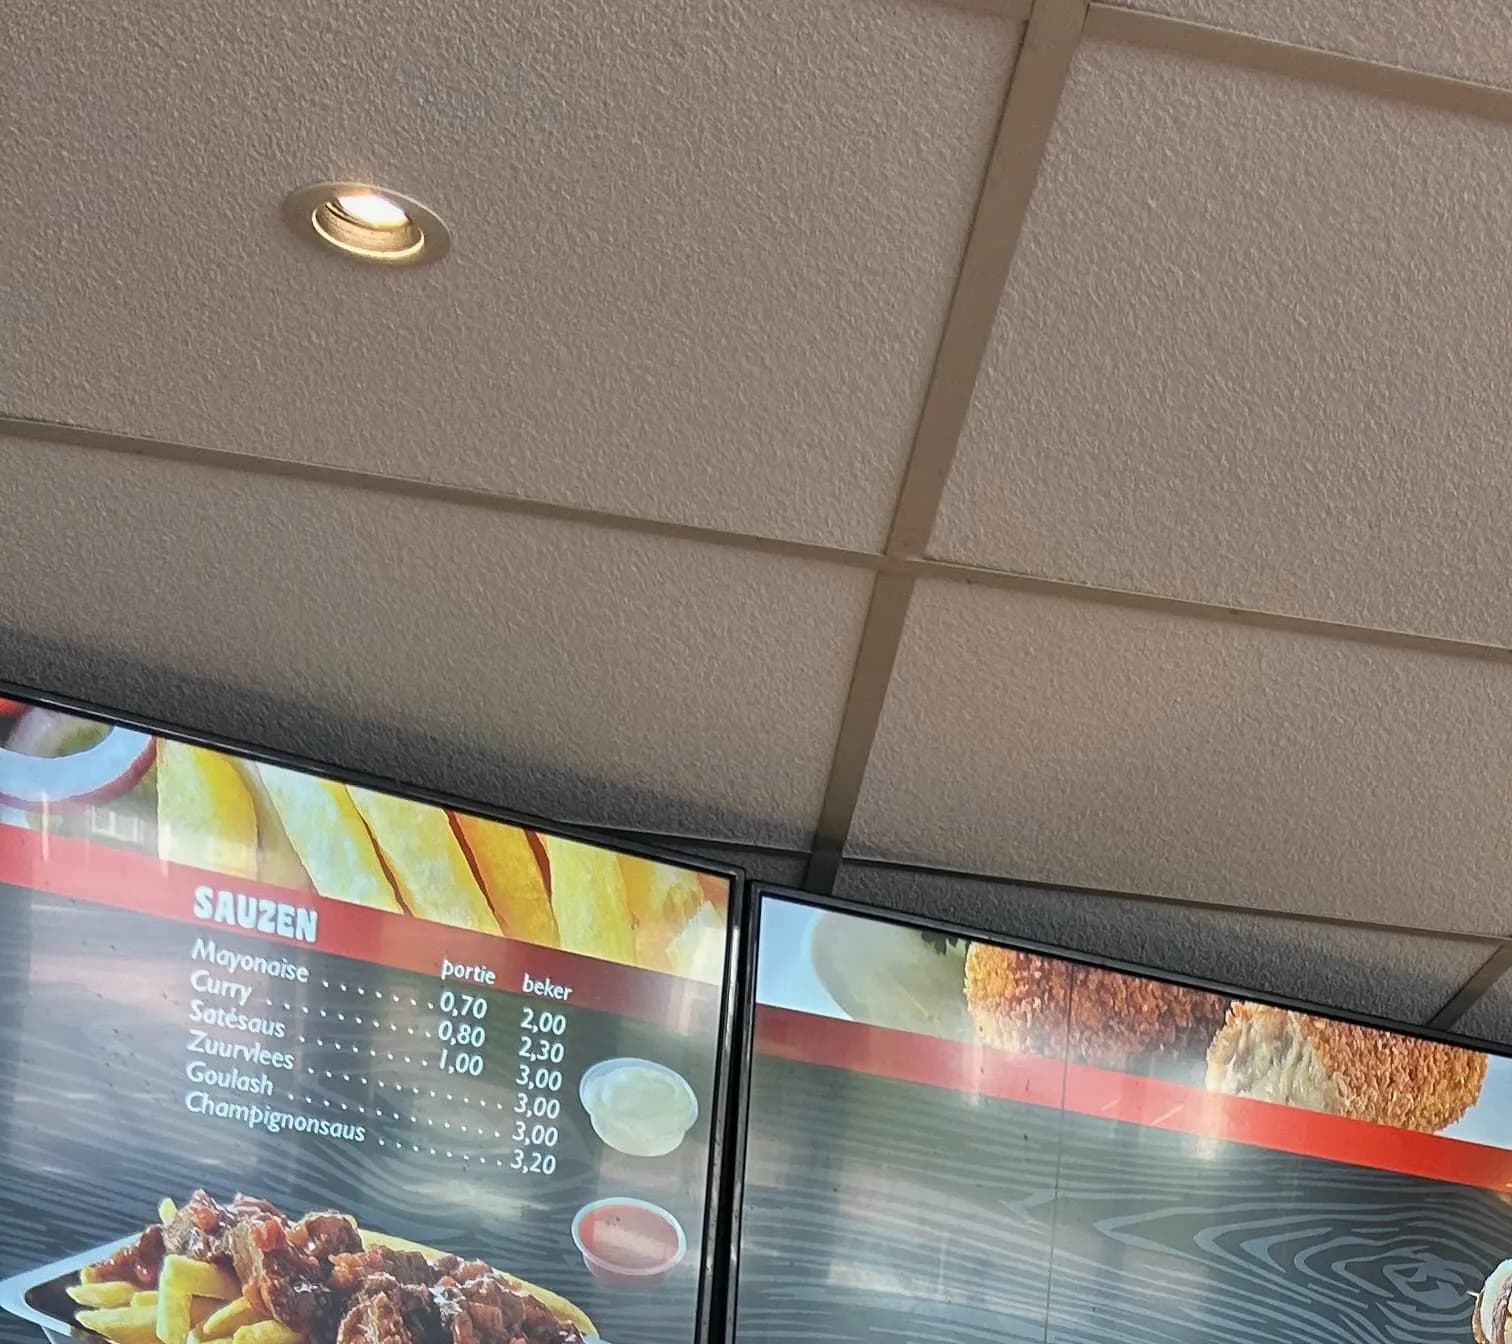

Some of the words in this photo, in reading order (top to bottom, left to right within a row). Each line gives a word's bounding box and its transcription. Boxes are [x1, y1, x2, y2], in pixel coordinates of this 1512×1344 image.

[193, 885, 317, 942] SAUZEN
[190, 937, 309, 983] Mayonaise
[440, 991, 487, 1019] 0,70
[520, 1007, 566, 1035] 2,00
[190, 969, 252, 1006] Curry
[438, 1019, 485, 1047] 0,80
[519, 1036, 564, 1063] 2,30
[441, 959, 495, 984] portie
[522, 973, 572, 1000] beker
[185, 1029, 294, 1069] Zuurvlees
[514, 1093, 560, 1119] 3,00
[188, 999, 285, 1037] Satésaus
[439, 1048, 483, 1076] 1,00
[516, 1064, 562, 1091] 3,00
[184, 1090, 365, 1141] Champignonsaus
[510, 1149, 556, 1174] 3,20
[186, 1061, 273, 1096] Goulash
[512, 1121, 558, 1147] 3,00
